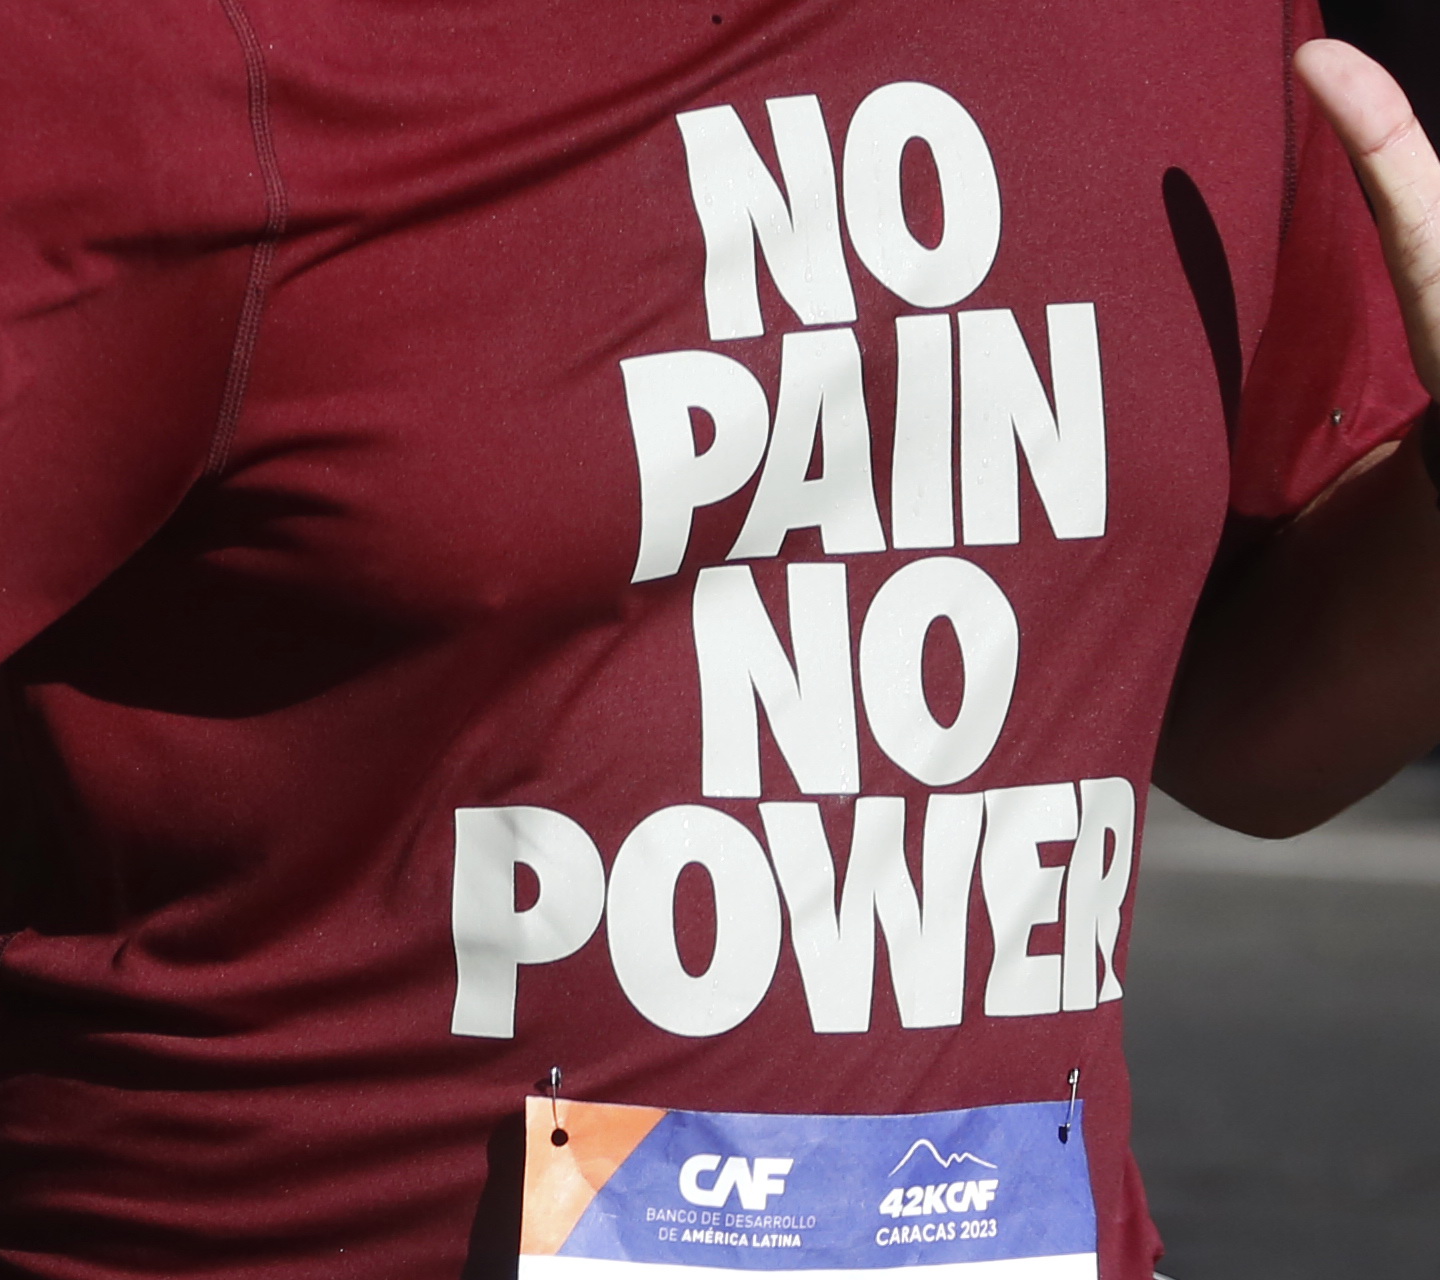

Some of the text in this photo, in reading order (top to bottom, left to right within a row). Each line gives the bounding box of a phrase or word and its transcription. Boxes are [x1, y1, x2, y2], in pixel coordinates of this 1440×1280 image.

[676, 81, 1002, 341] NO
[620, 302, 1107, 580] PAIN
[692, 556, 1020, 798] NO
[451, 776, 1136, 1039] POWER
[646, 1207, 816, 1229] BANCO DE DESARROLLO
[658, 1227, 802, 1248] DE AMÉRICA LATINA
[679, 1153, 794, 1210] CAF
[876, 1219, 997, 1246] CARACAS 2023
